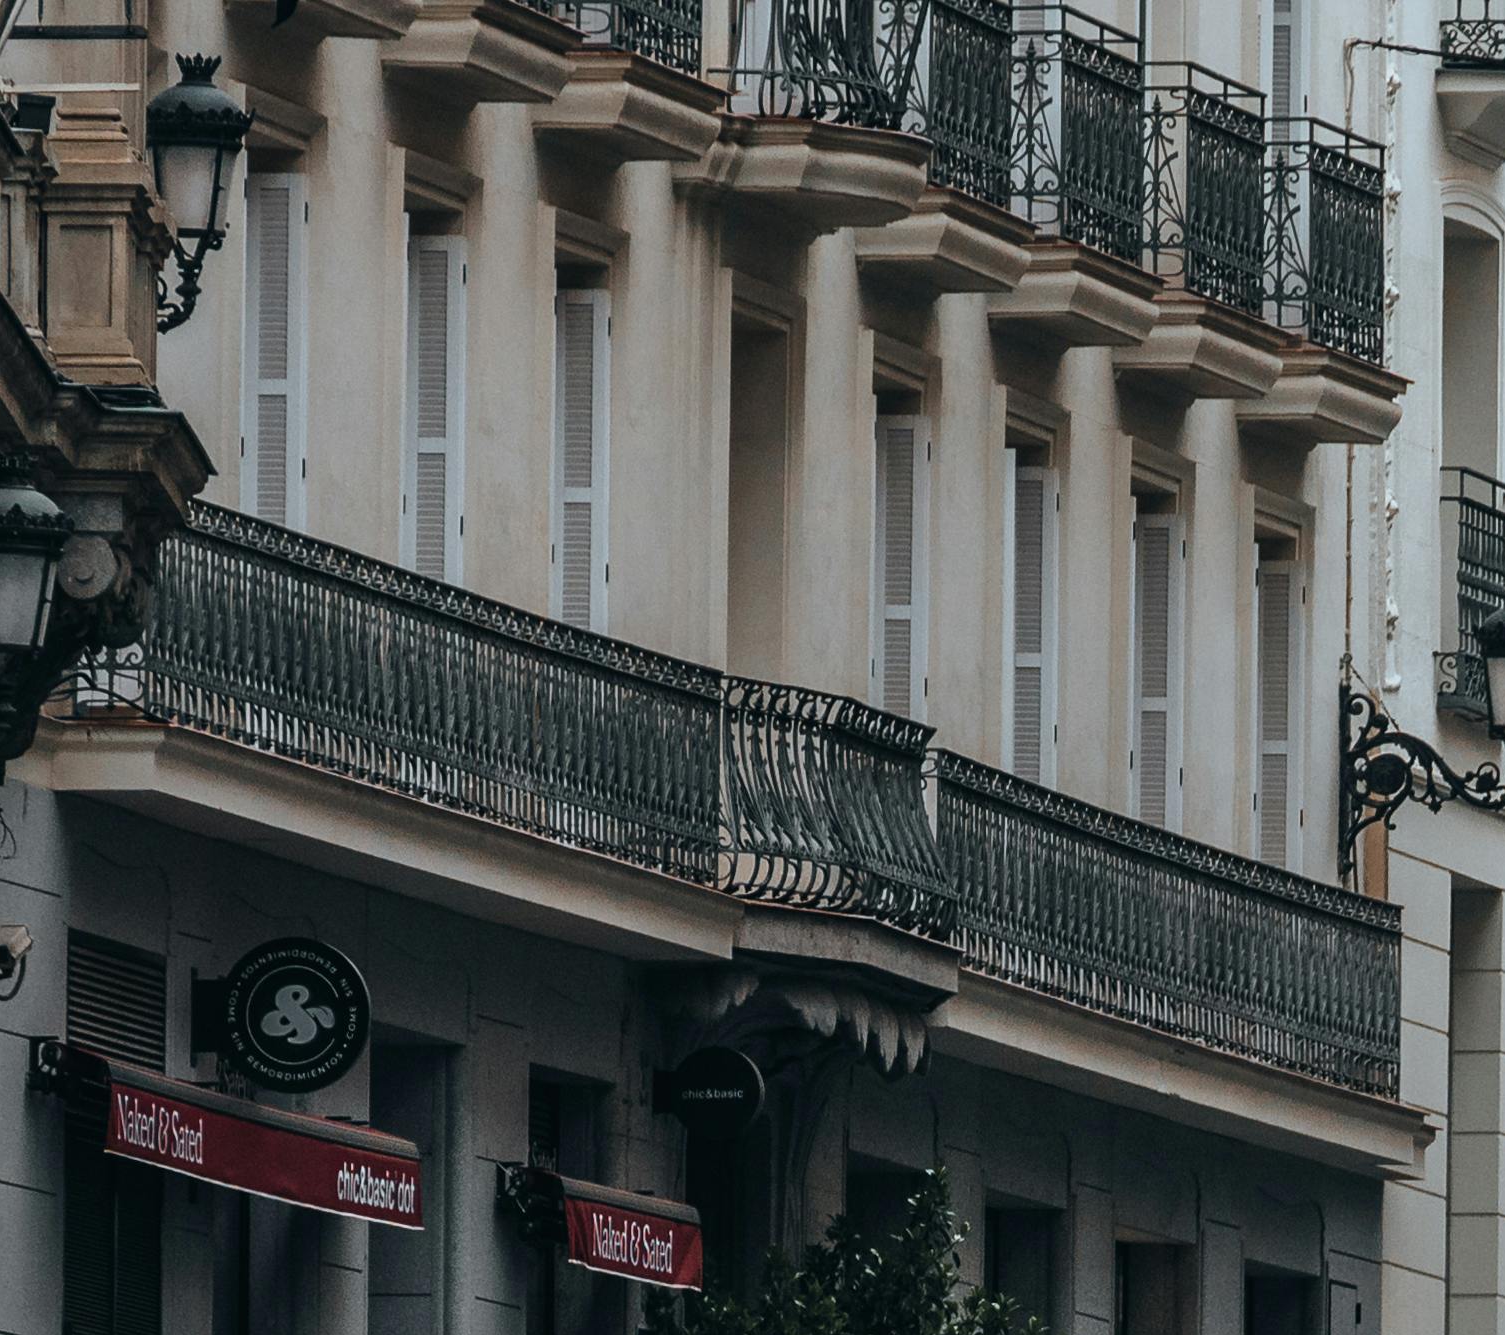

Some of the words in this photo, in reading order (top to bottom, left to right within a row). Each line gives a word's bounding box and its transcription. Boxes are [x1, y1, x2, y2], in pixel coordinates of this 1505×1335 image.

[681, 1087, 744, 1100] chic&basic
[116, 1093, 156, 1150] Naked
[158, 1106, 170, 1155] &
[170, 1110, 203, 1165] Sated
[336, 1162, 396, 1210] chic&basic
[397, 1172, 415, 1215] dot
[591, 1212, 628, 1265] Naked
[630, 1221, 641, 1267] &
[642, 1224, 673, 1275] Sated
